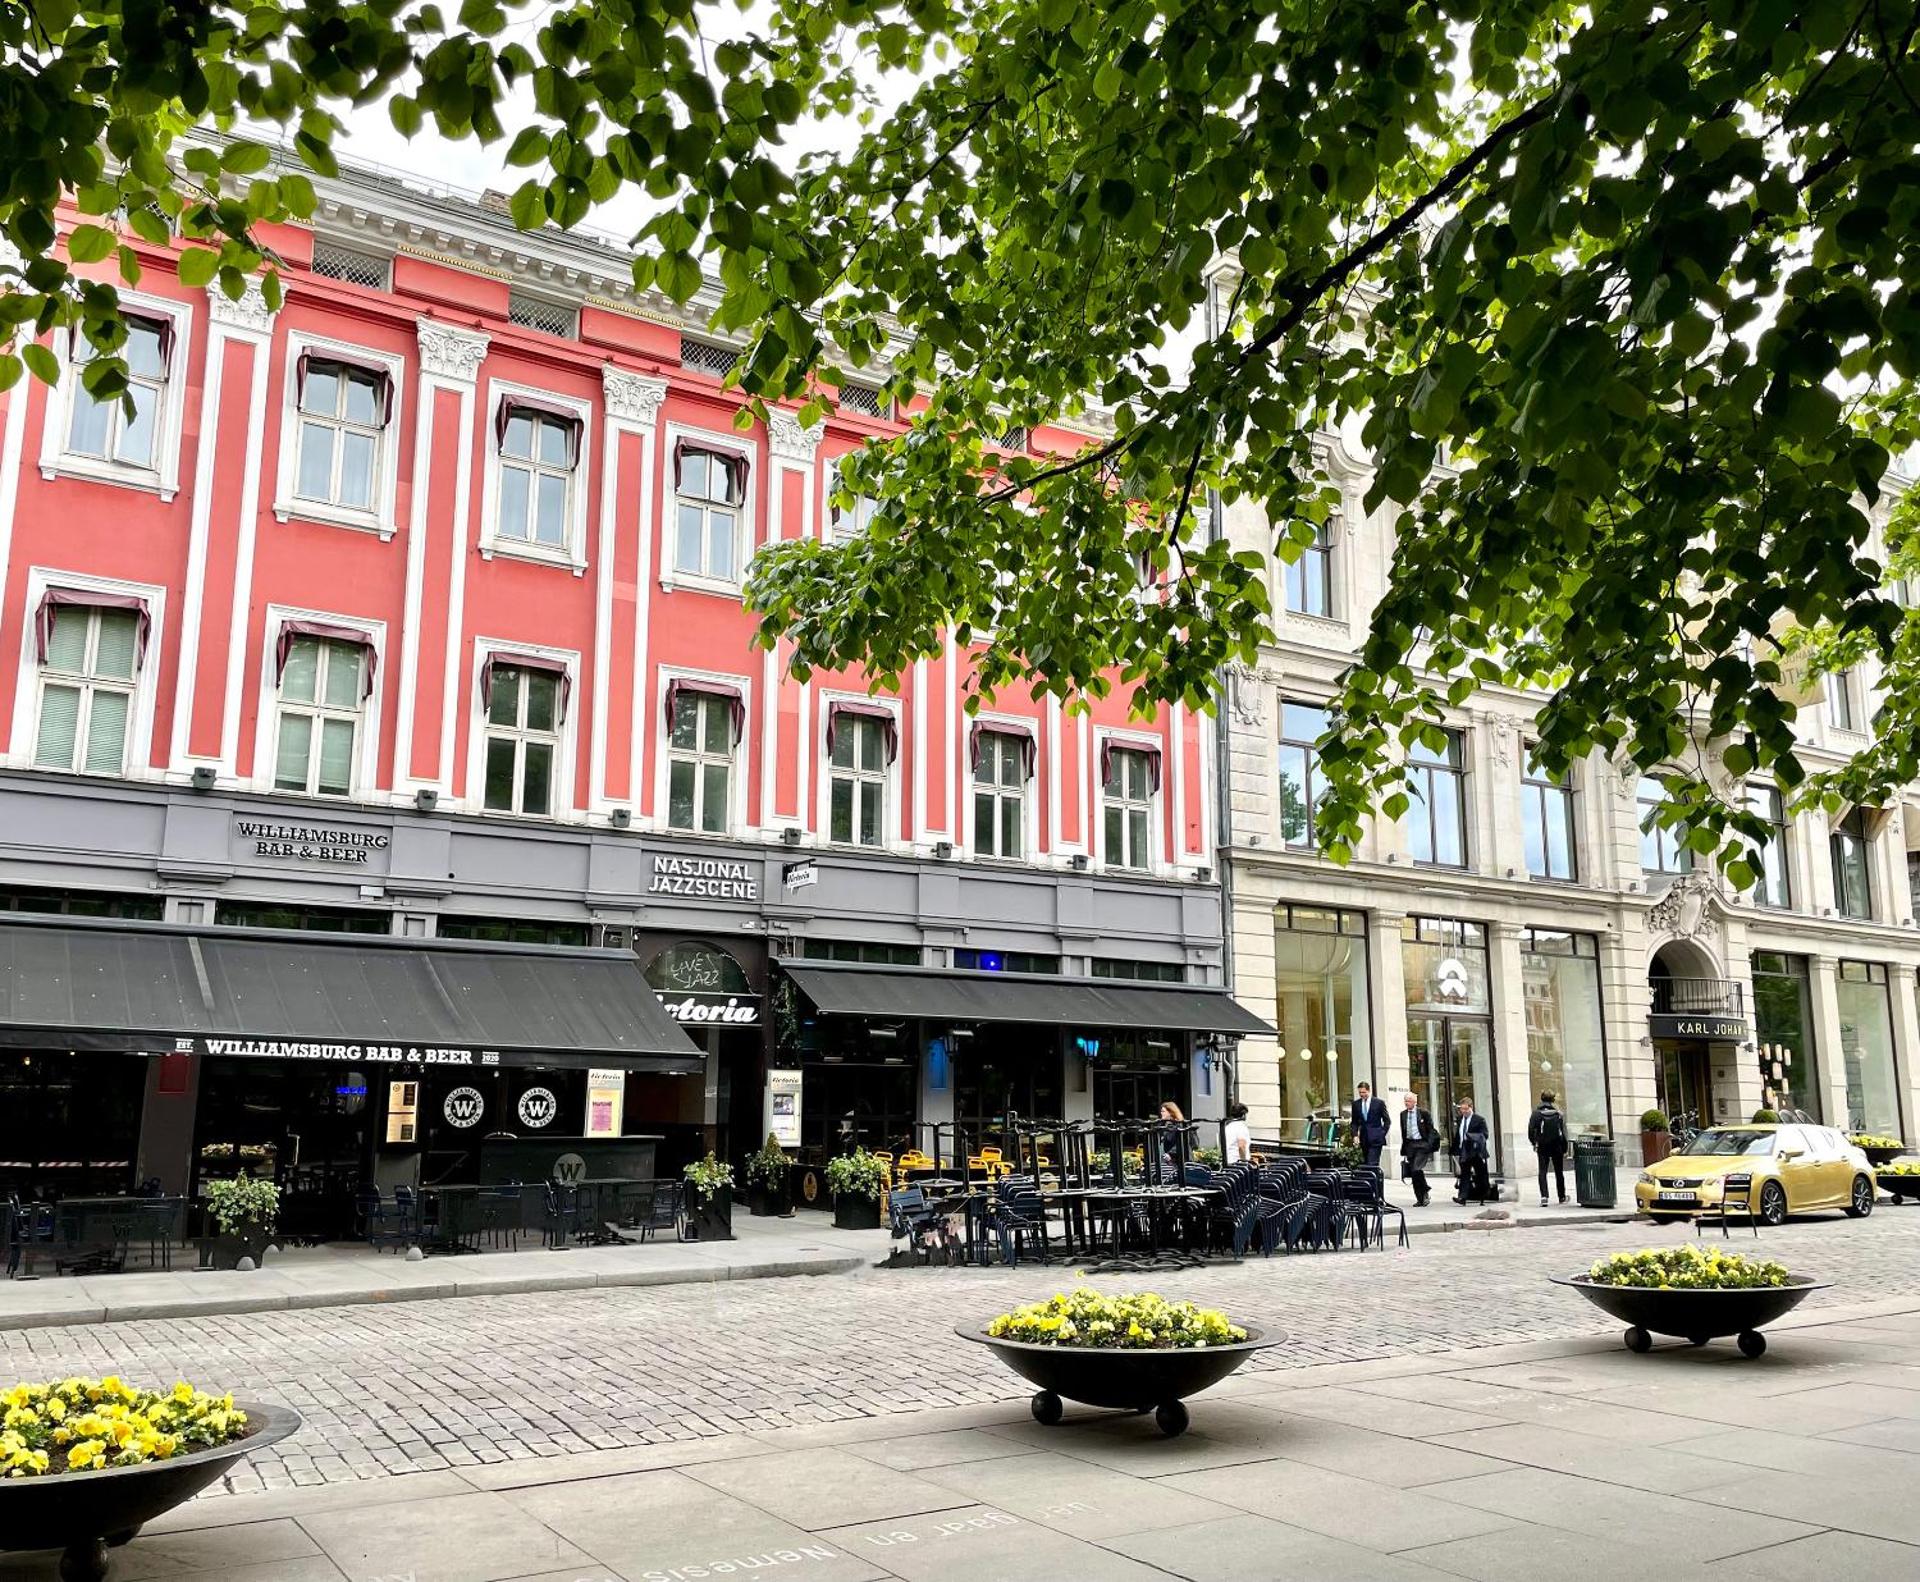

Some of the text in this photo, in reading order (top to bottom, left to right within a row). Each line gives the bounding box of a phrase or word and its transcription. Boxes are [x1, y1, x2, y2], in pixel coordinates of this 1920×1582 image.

[238, 822, 389, 849] WILLIAMSBURG
[256, 842, 368, 863] BAB & BEER
[653, 856, 754, 880] NASJONAL
[649, 875, 757, 899] JAZZSCENE
[684, 970, 719, 988] JAZZ
[1677, 1022, 1709, 1034] KARL
[205, 1039, 472, 1064] WILLIAMSBURG BAB & BEER
[453, 1100, 476, 1117] W
[527, 1100, 549, 1117] W
[557, 1163, 583, 1182] W
[932, 1512, 1021, 1536] gaar
[865, 1532, 920, 1546] en
[641, 1545, 838, 1582] Nemesis
